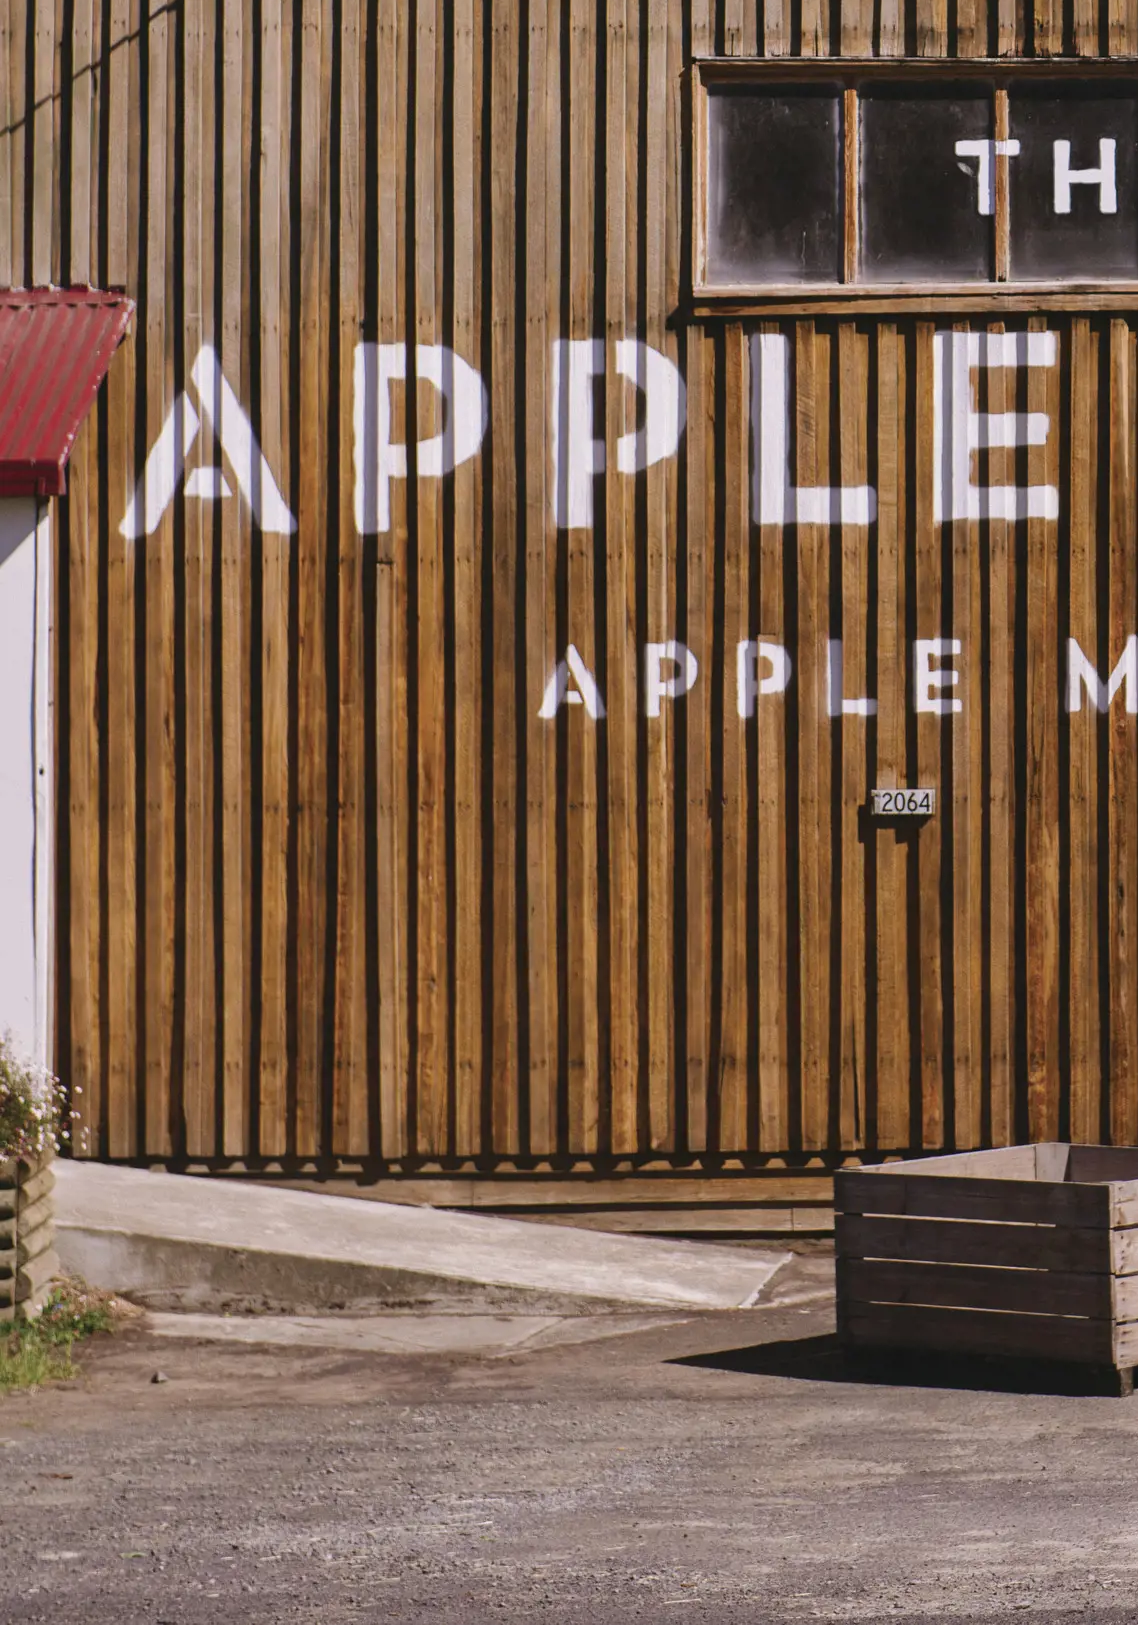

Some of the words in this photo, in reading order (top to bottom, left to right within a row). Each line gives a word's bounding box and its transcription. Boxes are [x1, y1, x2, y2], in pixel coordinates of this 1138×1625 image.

[118, 331, 1060, 540] APPLE
[538, 637, 962, 720] APPLE
[882, 792, 930, 812] 2064
